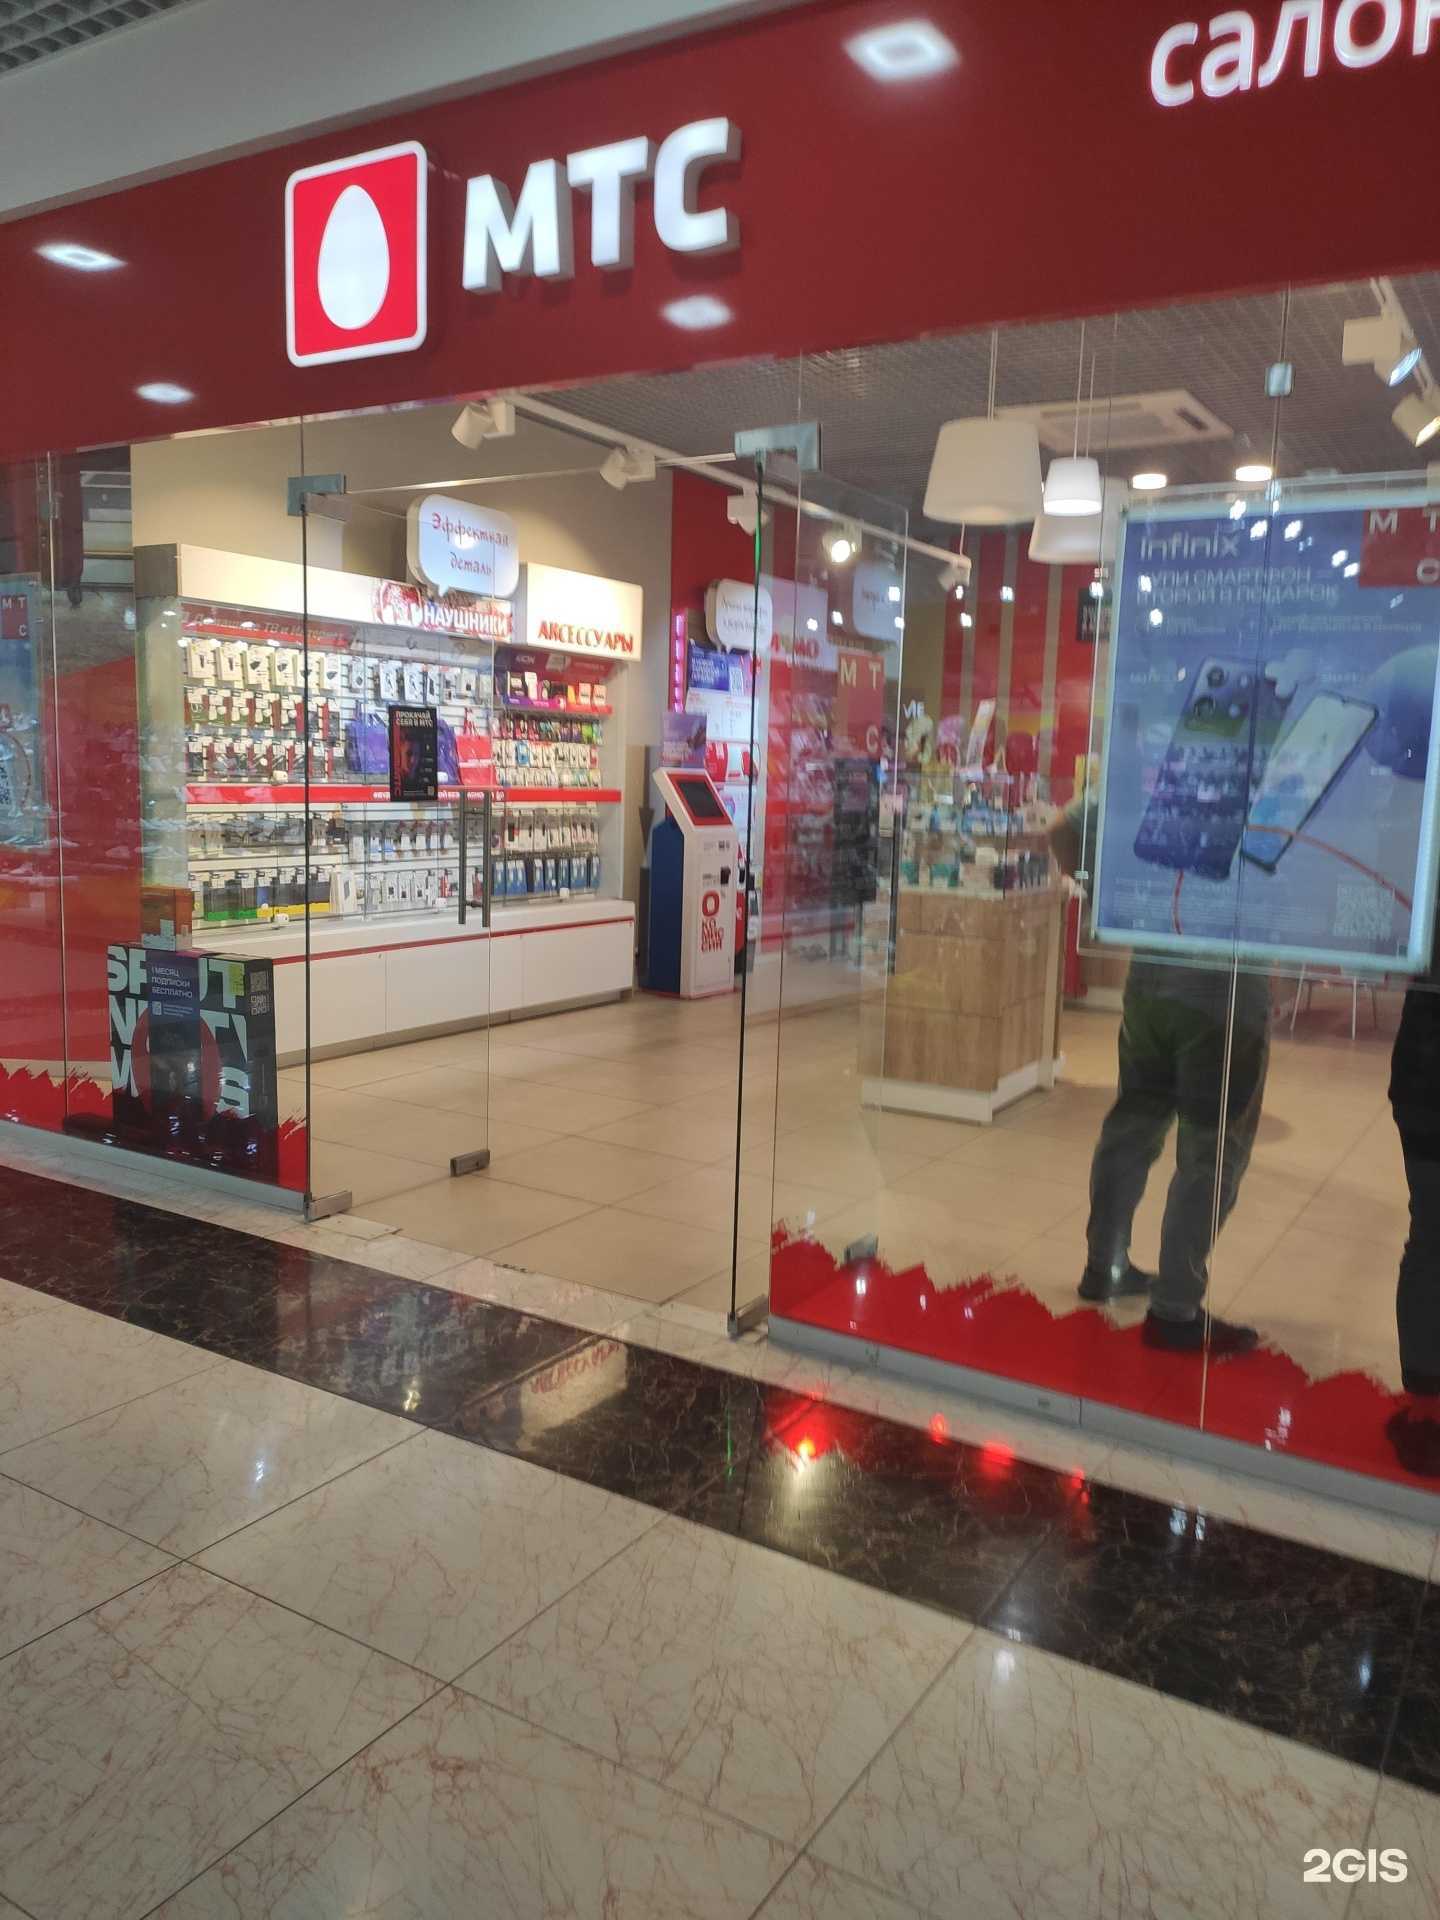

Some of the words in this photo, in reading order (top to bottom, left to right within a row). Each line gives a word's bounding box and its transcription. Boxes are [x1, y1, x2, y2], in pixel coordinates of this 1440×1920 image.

[462, 117, 741, 293] МТС
[431, 511, 510, 547] Эффектная
[449, 551, 492, 576] деталь
[422, 605, 508, 638] НАУШНИКИ
[538, 620, 635, 654] АКСЕССУАРЫ
[395, 710, 432, 719] ПРОКАЧАЙ
[152, 976, 191, 988] ПОДПИСКИ
[155, 967, 180, 978] МЕСЯЦ
[151, 986, 193, 999] БЕСПЛАТНО
